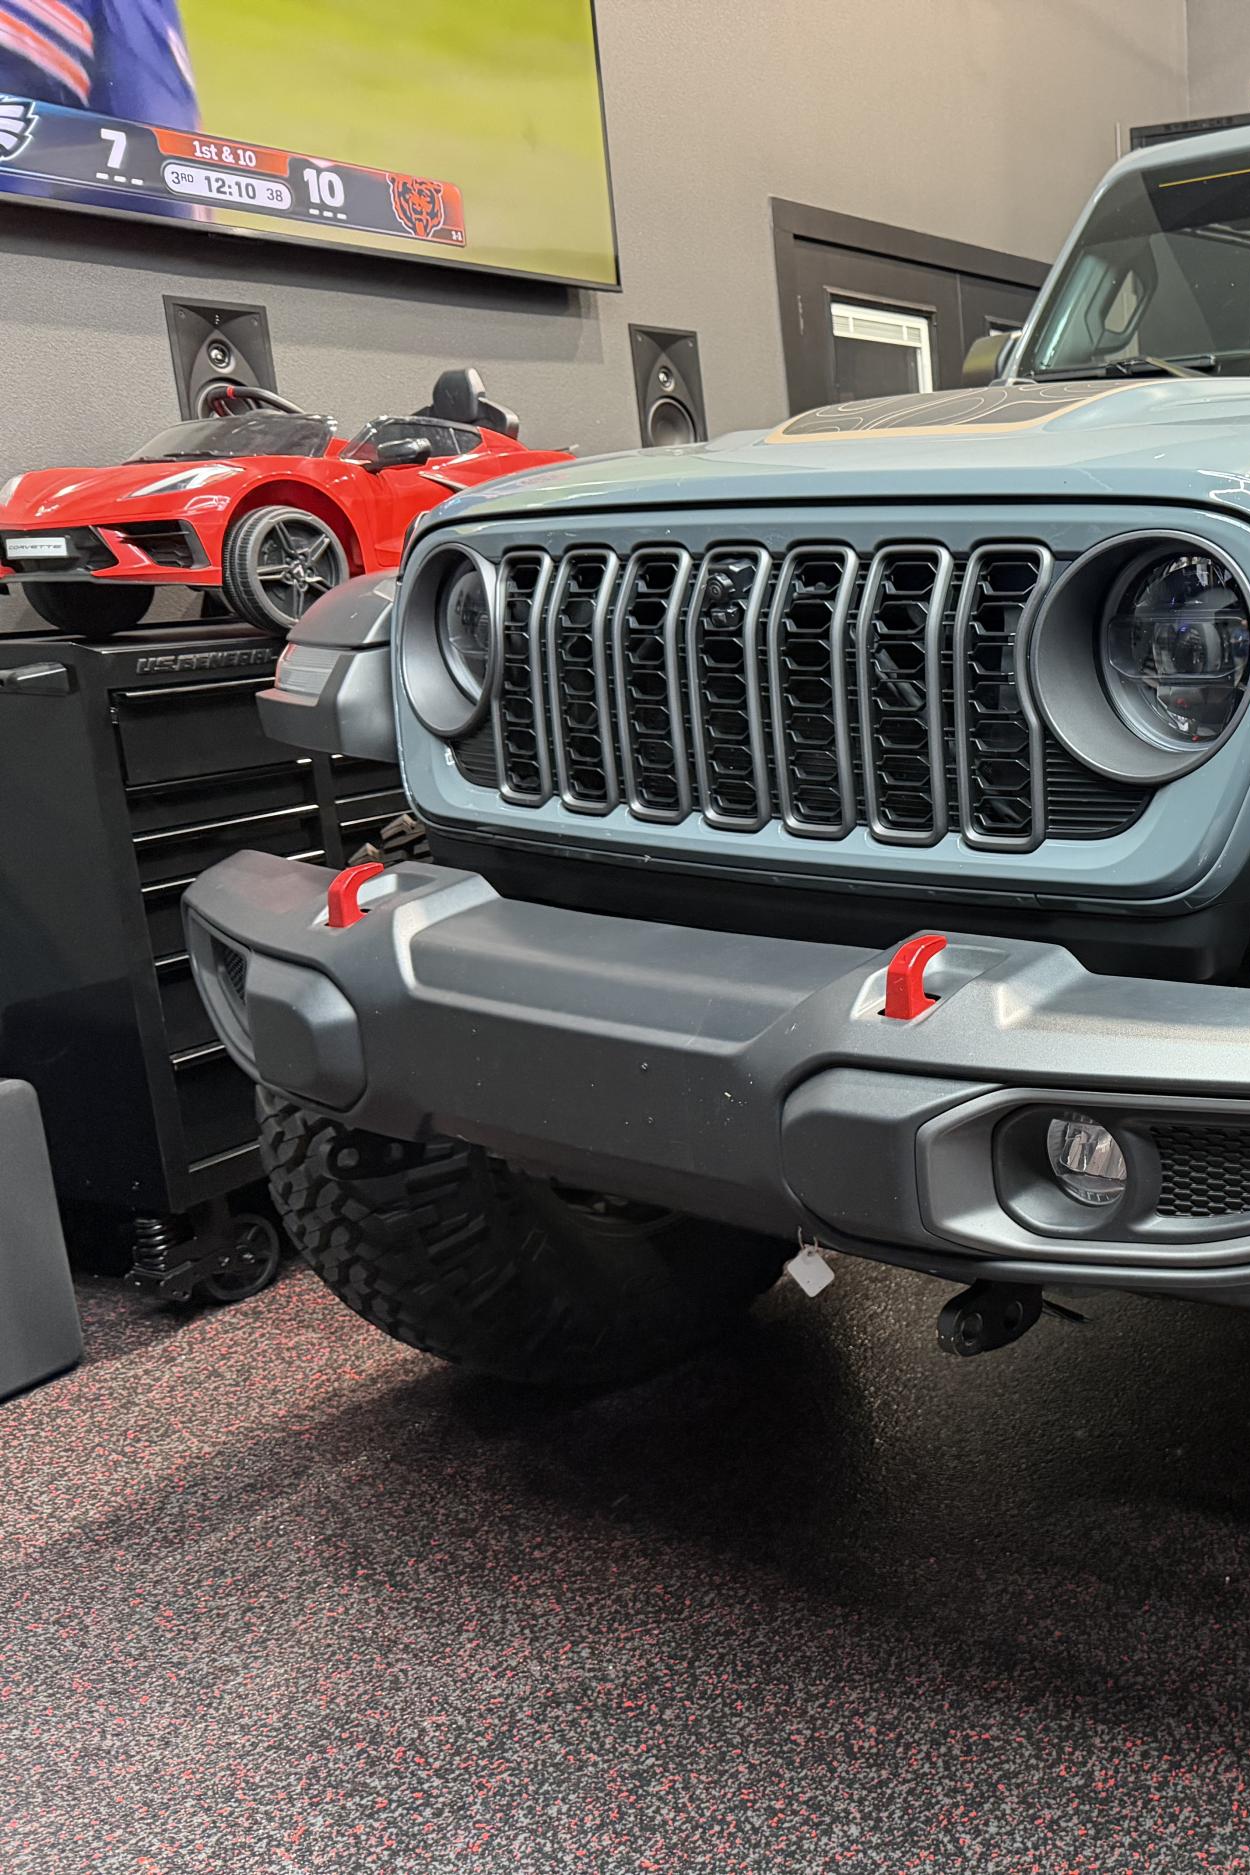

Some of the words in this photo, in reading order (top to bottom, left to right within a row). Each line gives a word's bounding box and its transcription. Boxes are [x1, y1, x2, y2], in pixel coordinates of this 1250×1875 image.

[100, 128, 127, 169] 7
[192, 140, 218, 161] 1st
[221, 147, 236, 163] &
[237, 149, 257, 168] 10
[171, 171, 194, 185] 3RD
[204, 175, 257, 200] 12:10
[266, 188, 283, 202] 38
[303, 168, 345, 208] 10
